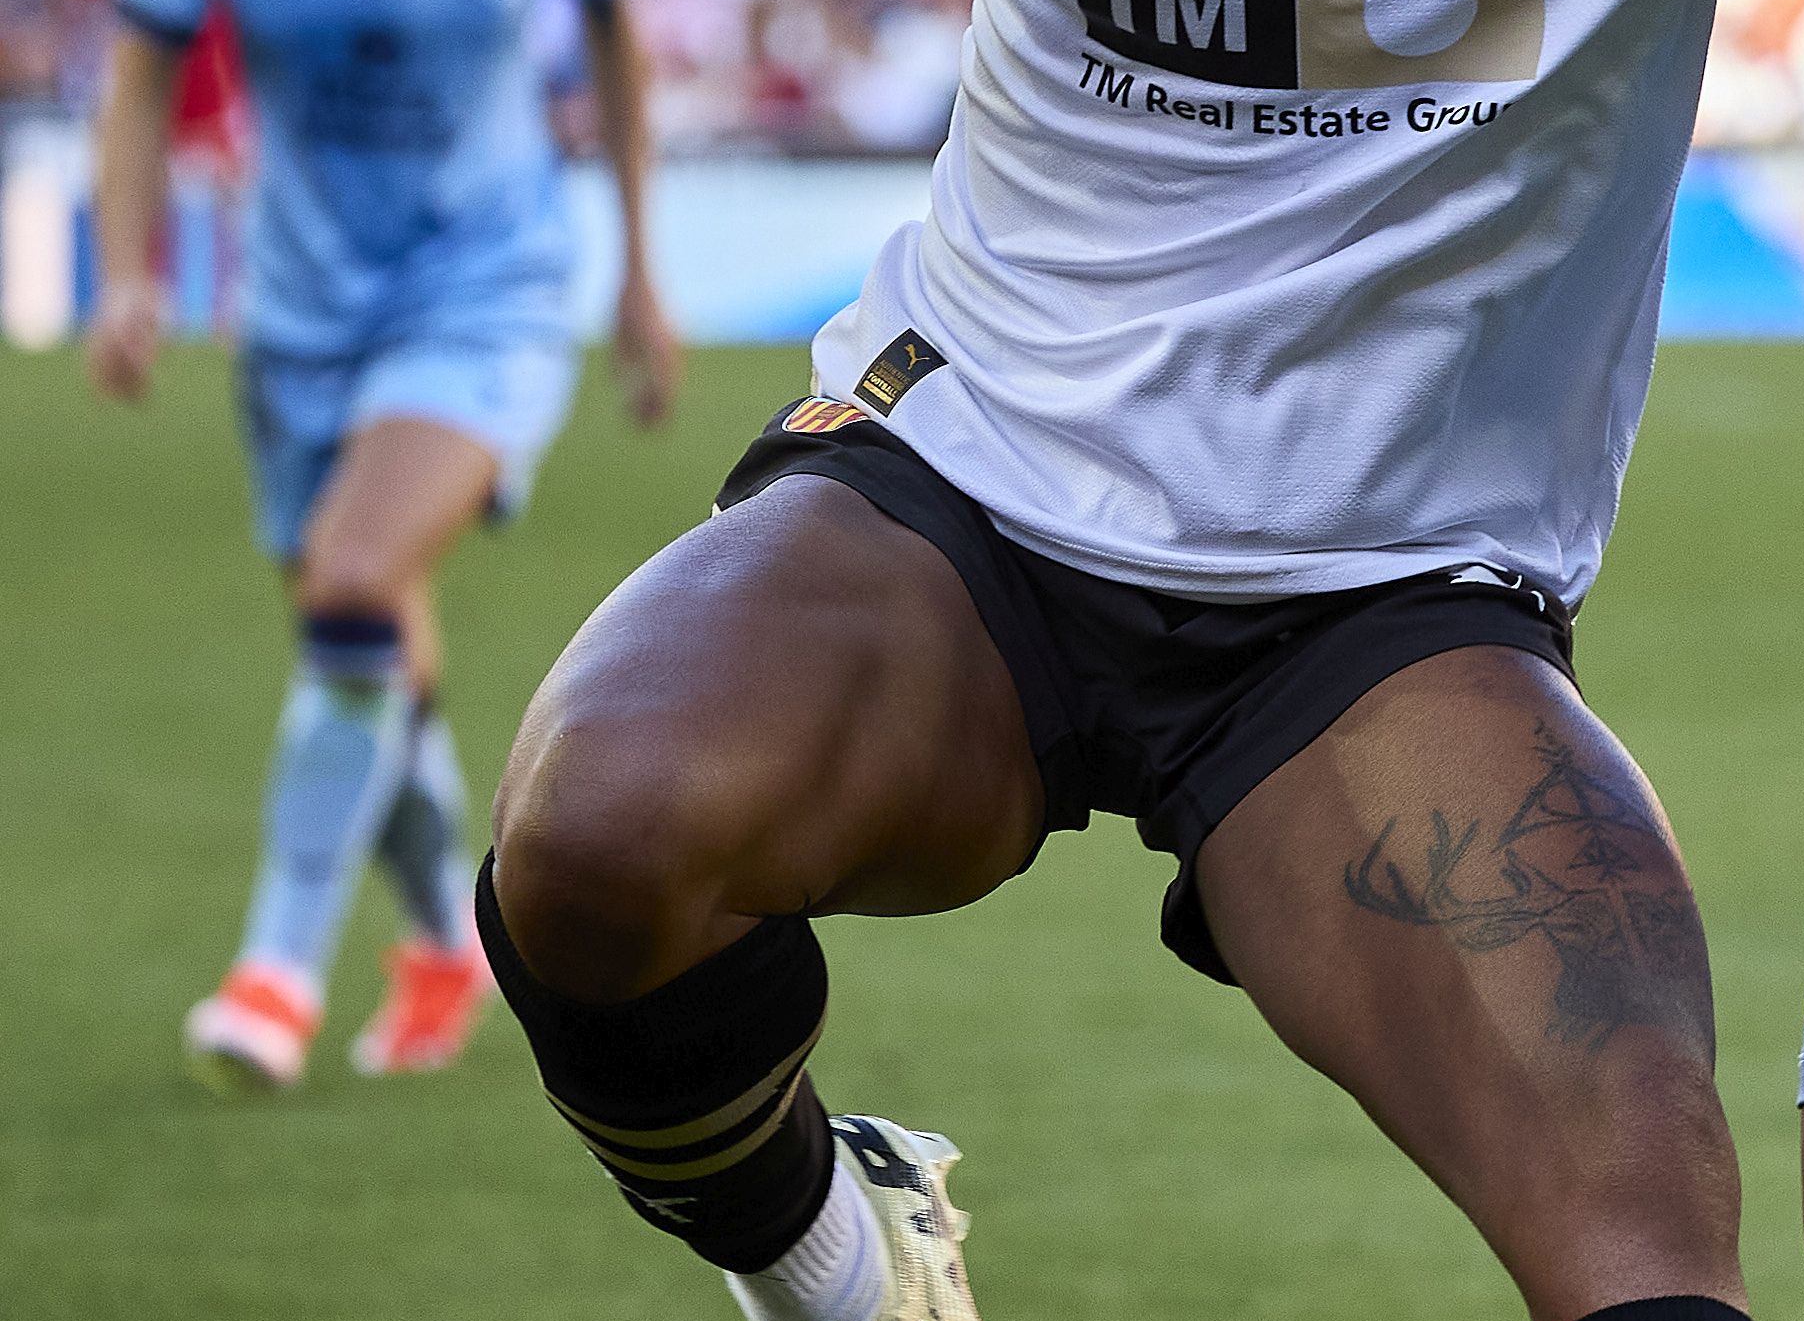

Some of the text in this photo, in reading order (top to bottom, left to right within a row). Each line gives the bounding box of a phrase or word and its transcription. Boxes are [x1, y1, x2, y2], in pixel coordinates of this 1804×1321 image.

[1078, 51, 1521, 138] TM Real Estate Grou
